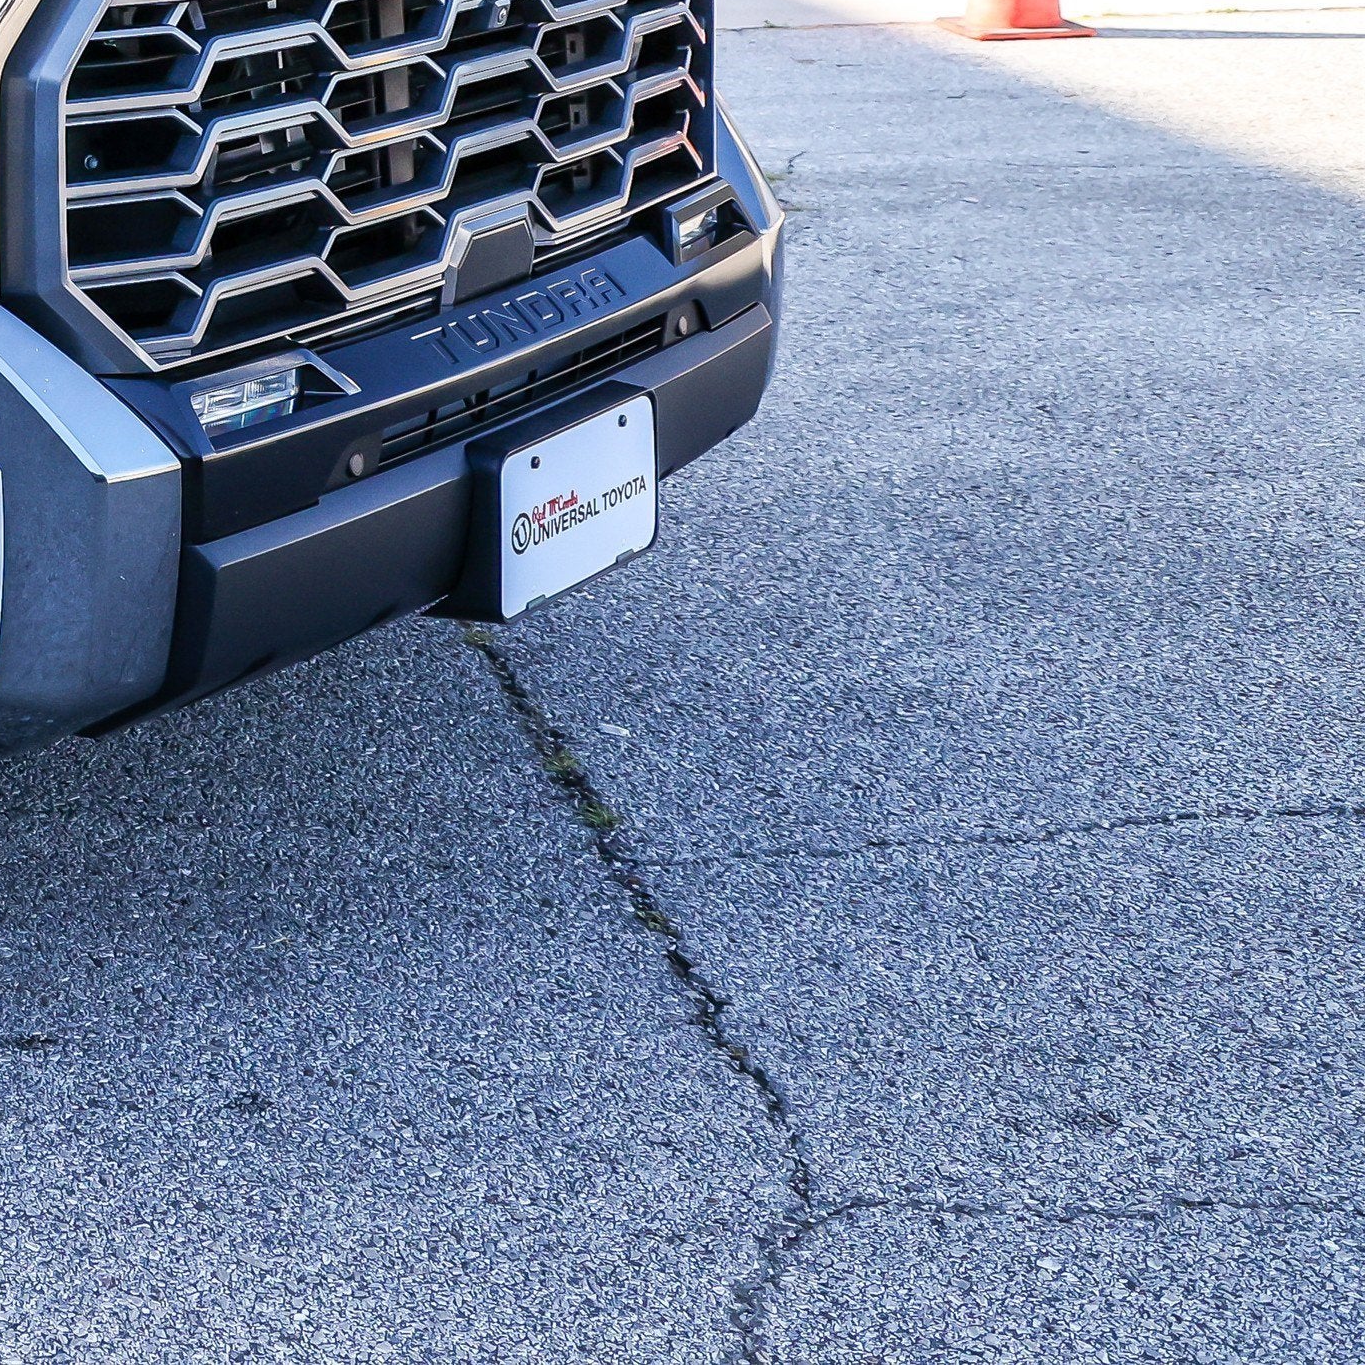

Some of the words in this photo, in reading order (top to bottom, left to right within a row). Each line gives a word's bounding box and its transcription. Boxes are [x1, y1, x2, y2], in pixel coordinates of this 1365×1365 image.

[410, 267, 627, 365] TUNDRA
[533, 498, 600, 545] UNIVERSAL
[602, 475, 647, 511] TOYOTA
